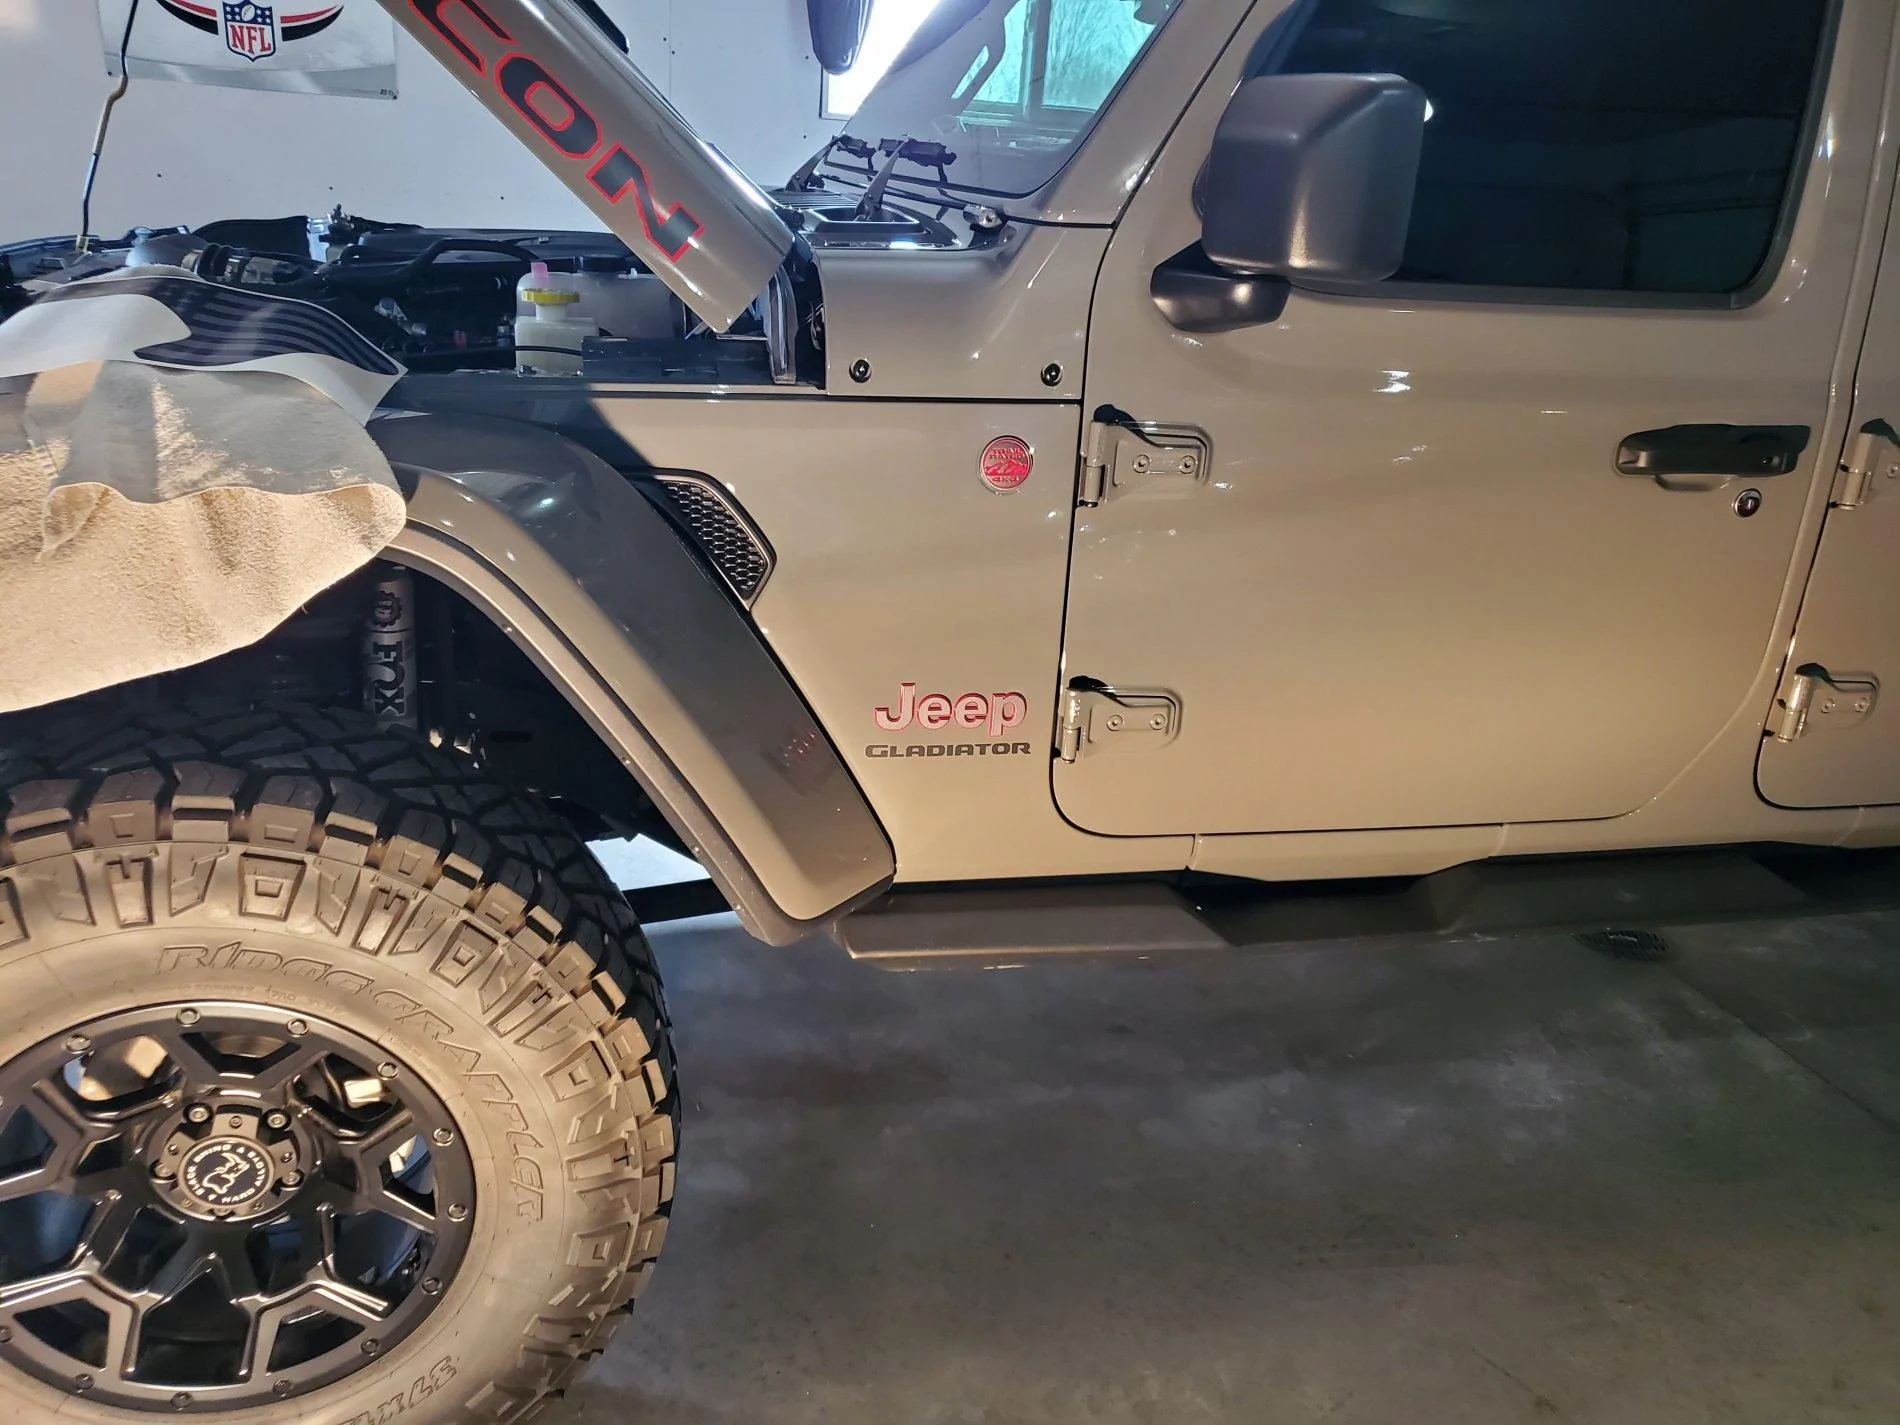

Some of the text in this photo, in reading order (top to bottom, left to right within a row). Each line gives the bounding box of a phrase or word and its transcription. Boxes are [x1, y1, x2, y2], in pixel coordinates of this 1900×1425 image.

[229, 24, 272, 55] NFL
[372, 640, 406, 716] FOX
[874, 682, 1028, 738] Jeep
[865, 742, 1032, 758] GLADIATOR
